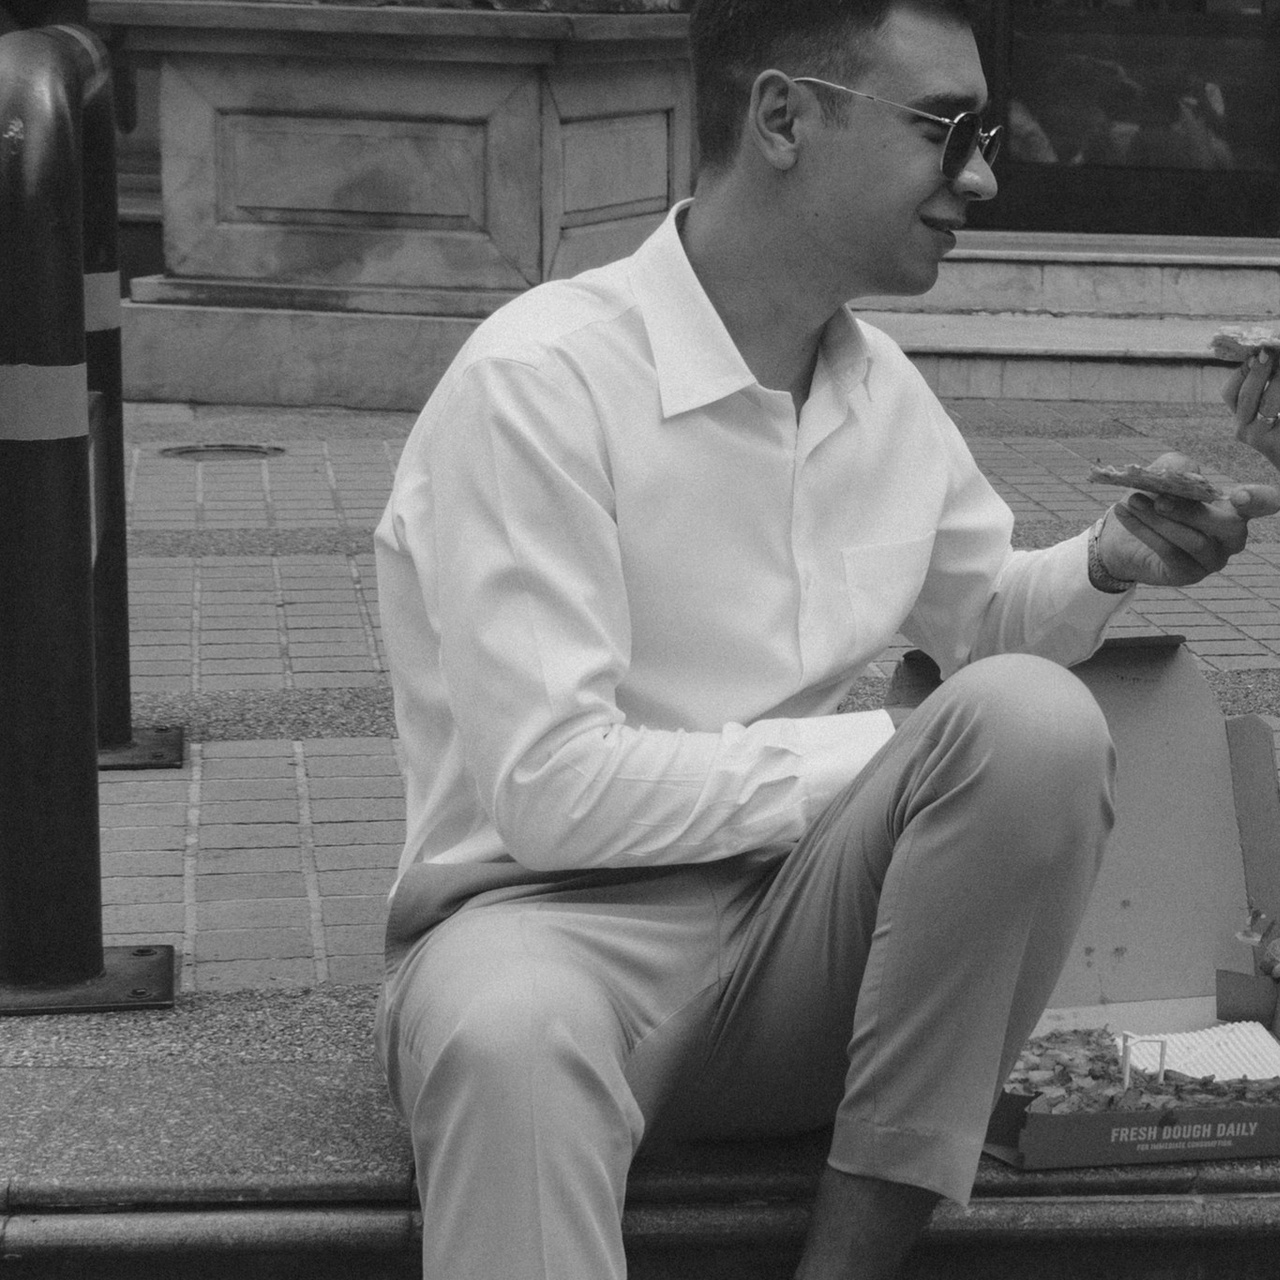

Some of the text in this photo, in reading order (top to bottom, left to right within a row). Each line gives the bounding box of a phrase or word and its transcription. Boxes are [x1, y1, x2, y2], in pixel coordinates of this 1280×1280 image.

[1110, 1122, 1258, 1143] FRESH DOUGH DAILY
[1136, 1143, 1149, 1152] FOR
[1151, 1142, 1186, 1151] IMMEDIATE
